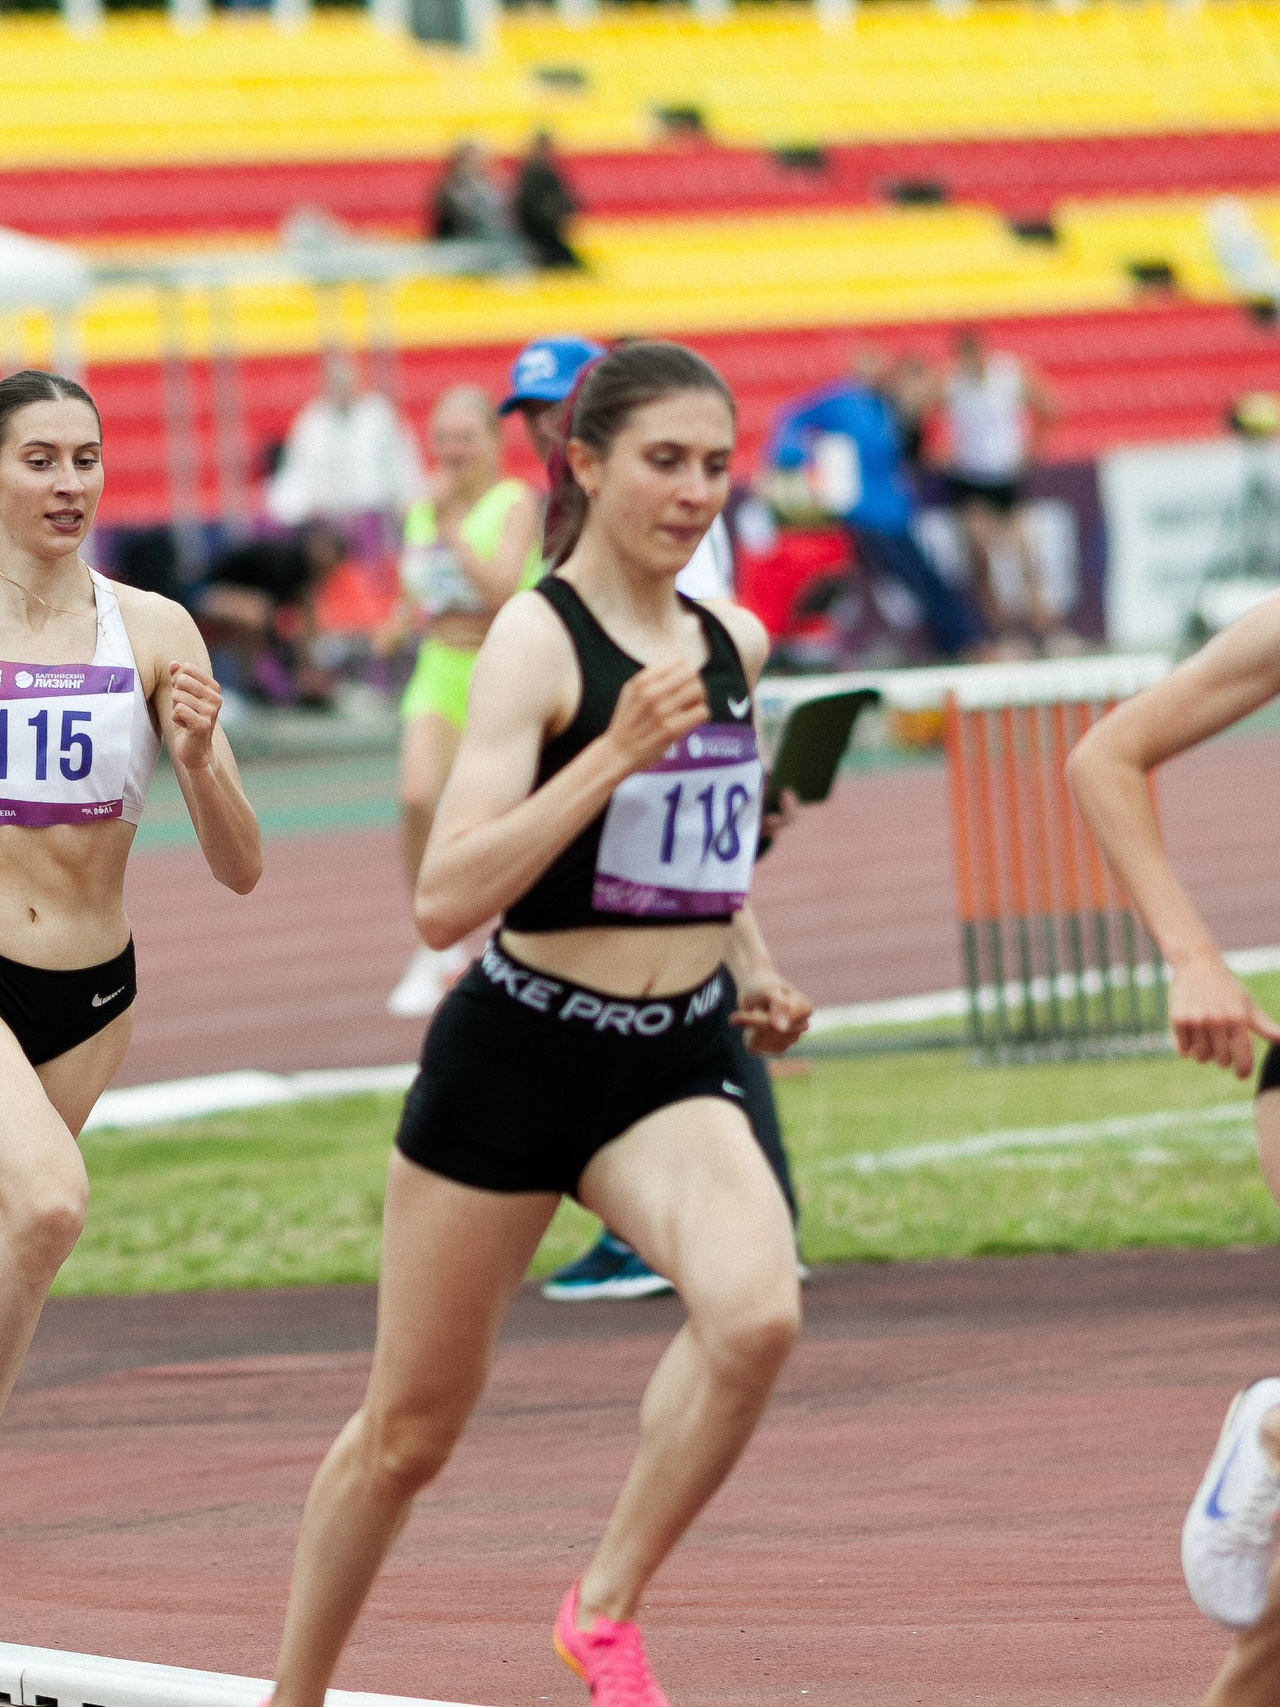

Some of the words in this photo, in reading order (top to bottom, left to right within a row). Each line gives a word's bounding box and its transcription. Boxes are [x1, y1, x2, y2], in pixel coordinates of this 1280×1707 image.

[33, 679, 85, 689] ЛИЗИНГ
[35, 672, 86, 680] БАЛТИЙСКИЙ
[660, 783, 748, 864] 118
[558, 991, 675, 1036] PRO
